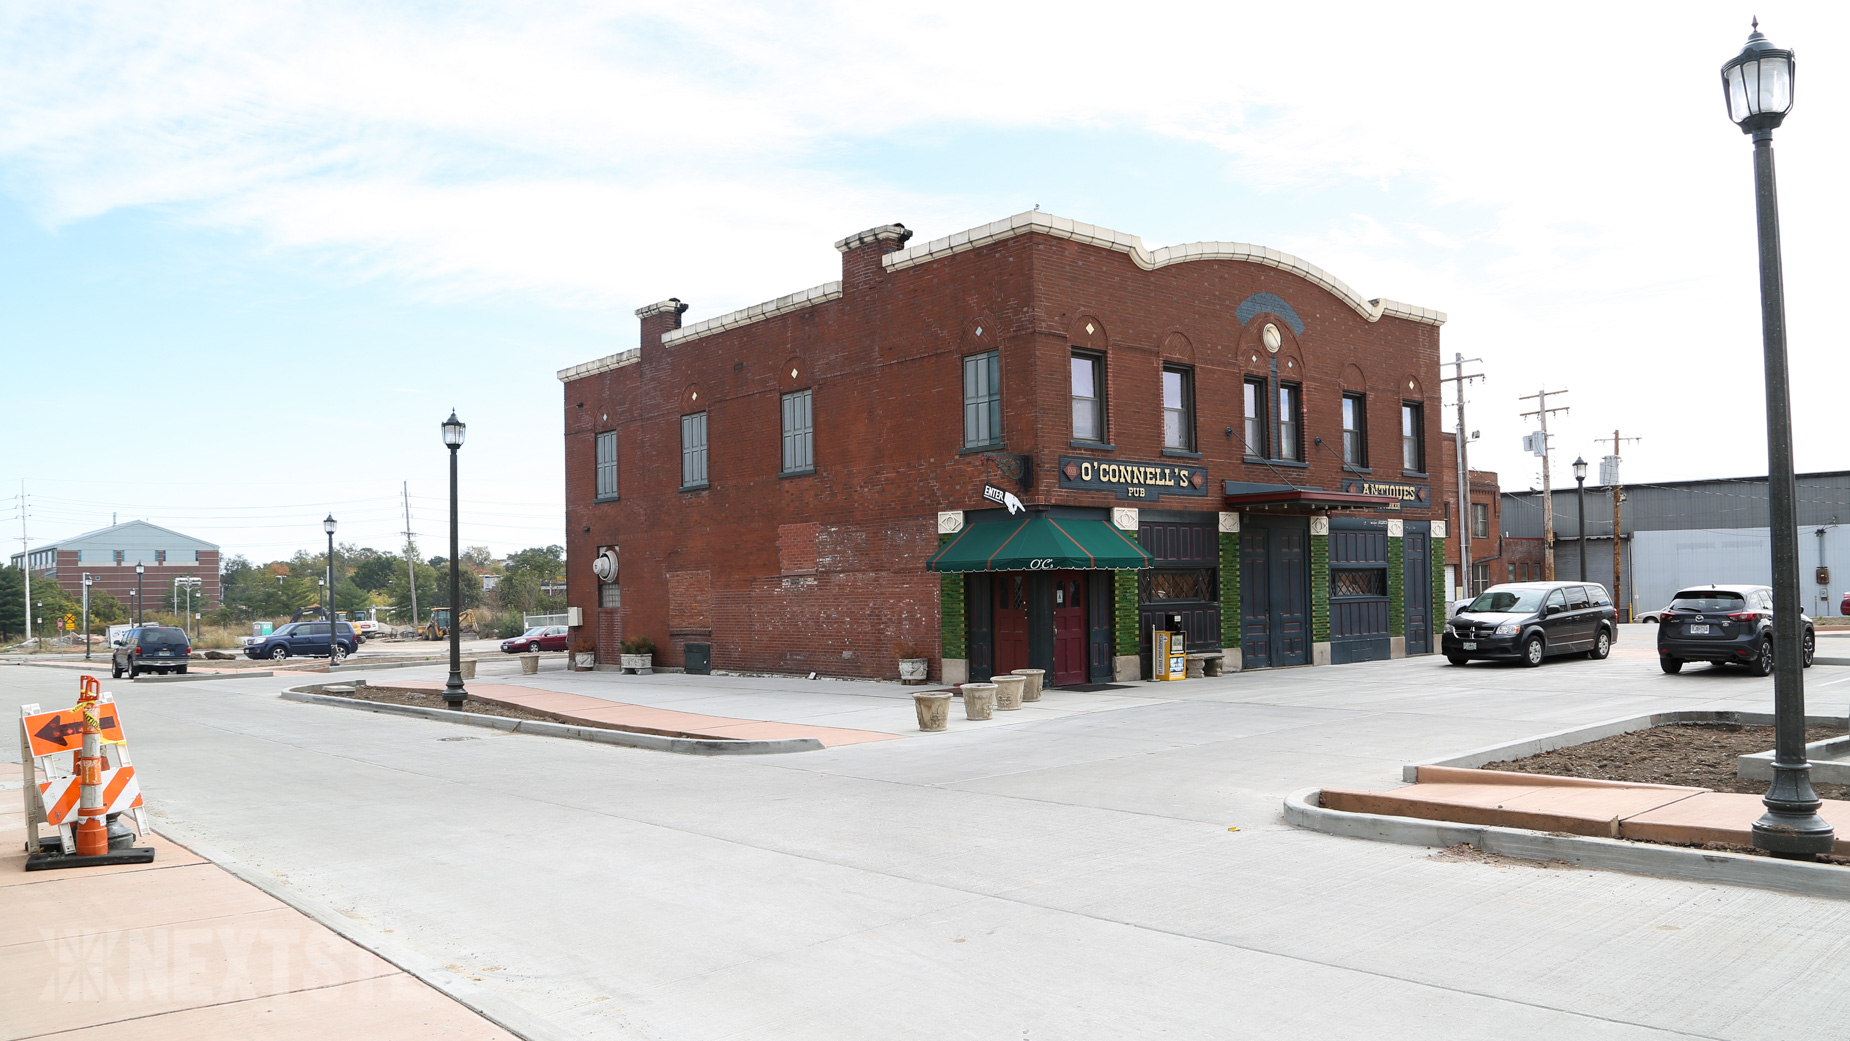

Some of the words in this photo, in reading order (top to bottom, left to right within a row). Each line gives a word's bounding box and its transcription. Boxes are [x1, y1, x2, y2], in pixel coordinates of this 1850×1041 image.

[1081, 461, 1189, 487] O'CONNELL'S
[984, 485, 1004, 501] ENTER
[1127, 487, 1146, 497] PUB
[1362, 483, 1416, 501] ANTIQUES
